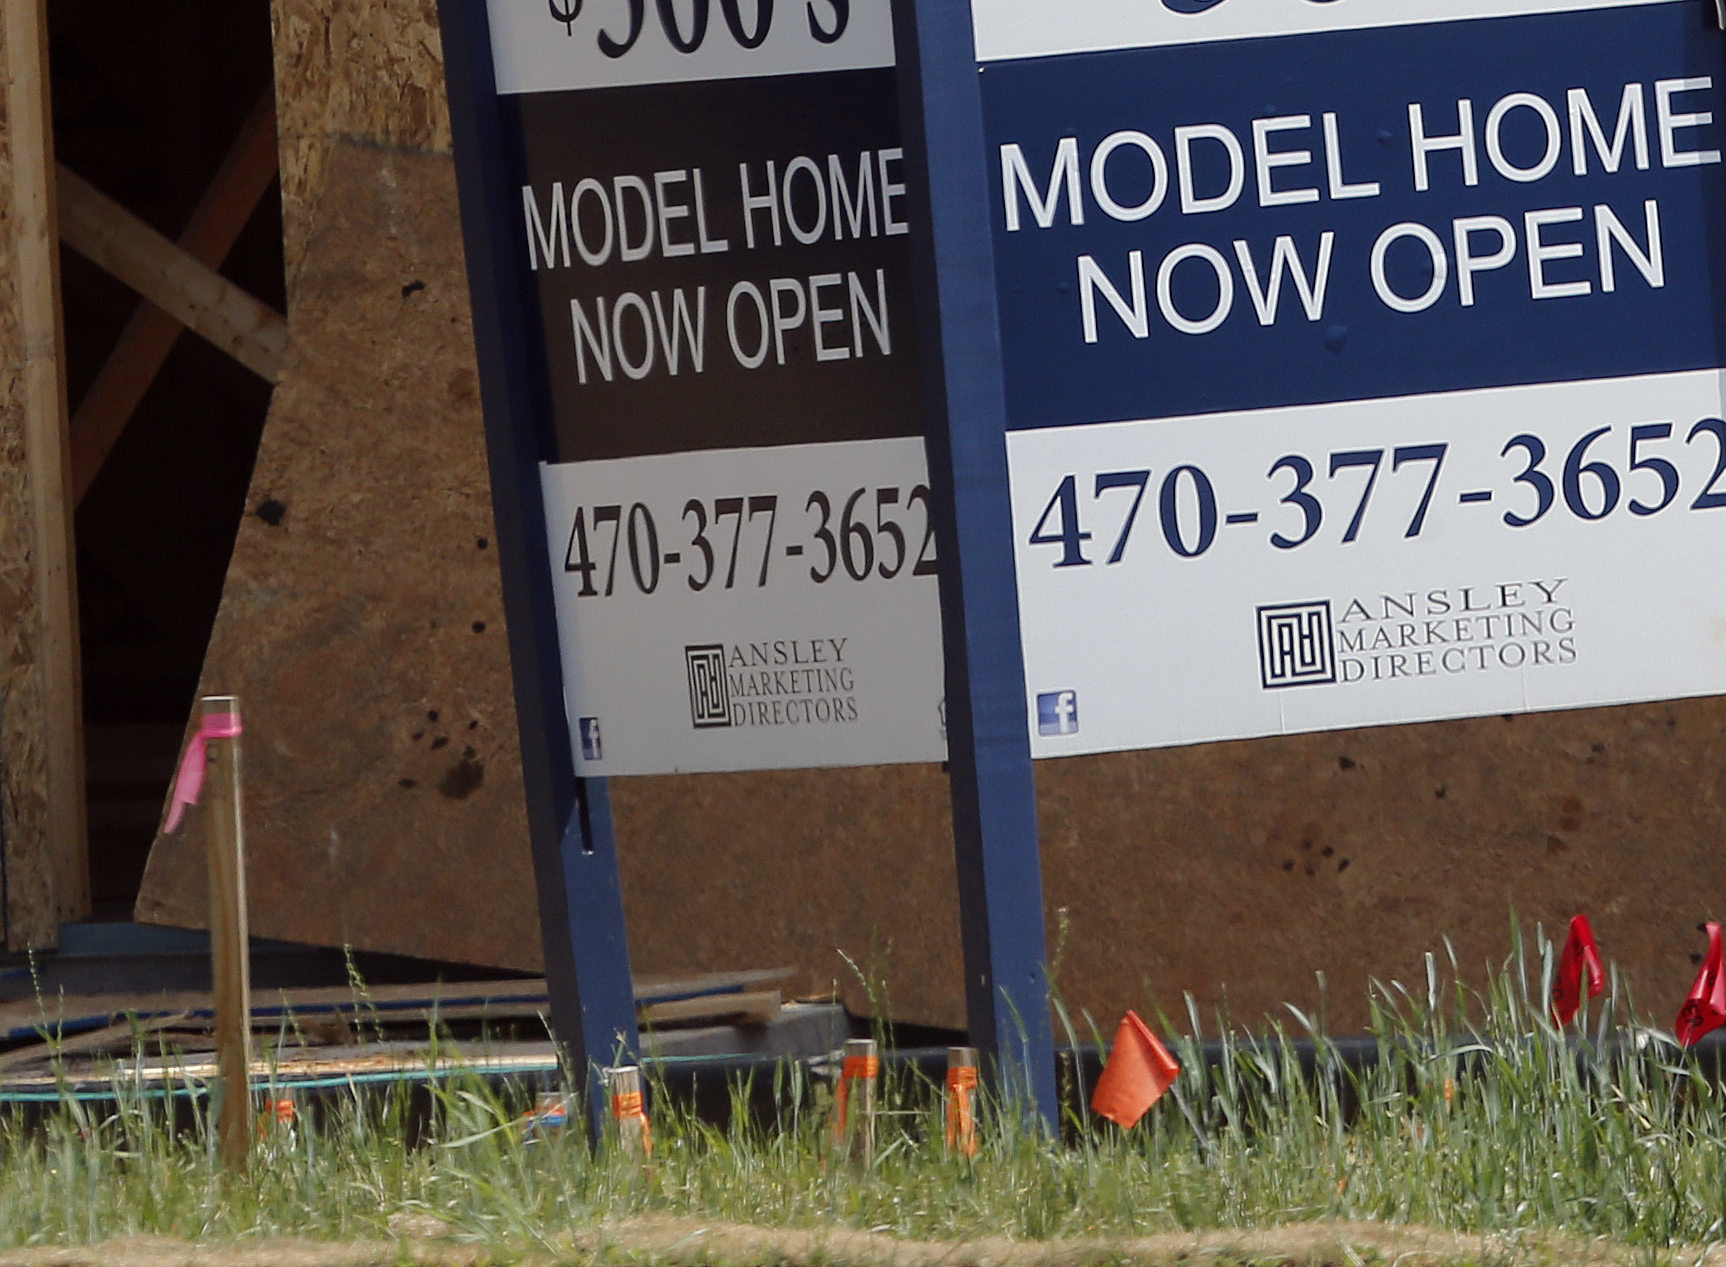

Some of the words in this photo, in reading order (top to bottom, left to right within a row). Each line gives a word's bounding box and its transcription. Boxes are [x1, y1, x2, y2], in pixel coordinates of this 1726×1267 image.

[1000, 111, 1381, 232] MODEL
[1407, 76, 1722, 193] HOME
[522, 168, 729, 271] MODEL
[739, 147, 909, 249] HOME
[1077, 230, 1335, 344] NOW
[1370, 199, 1665, 314] OPEN
[570, 285, 706, 385] NOW
[726, 268, 892, 370] OPEN
[564, 484, 939, 597] 470-377-3652
[1339, 577, 1569, 623] ANSLEY
[728, 637, 849, 668] ANSLEY
[1337, 607, 1575, 654] MARKETING
[729, 666, 855, 698] MARKETING
[1340, 637, 1578, 684] DIRECTORS
[732, 696, 858, 727] DIRECTORS
